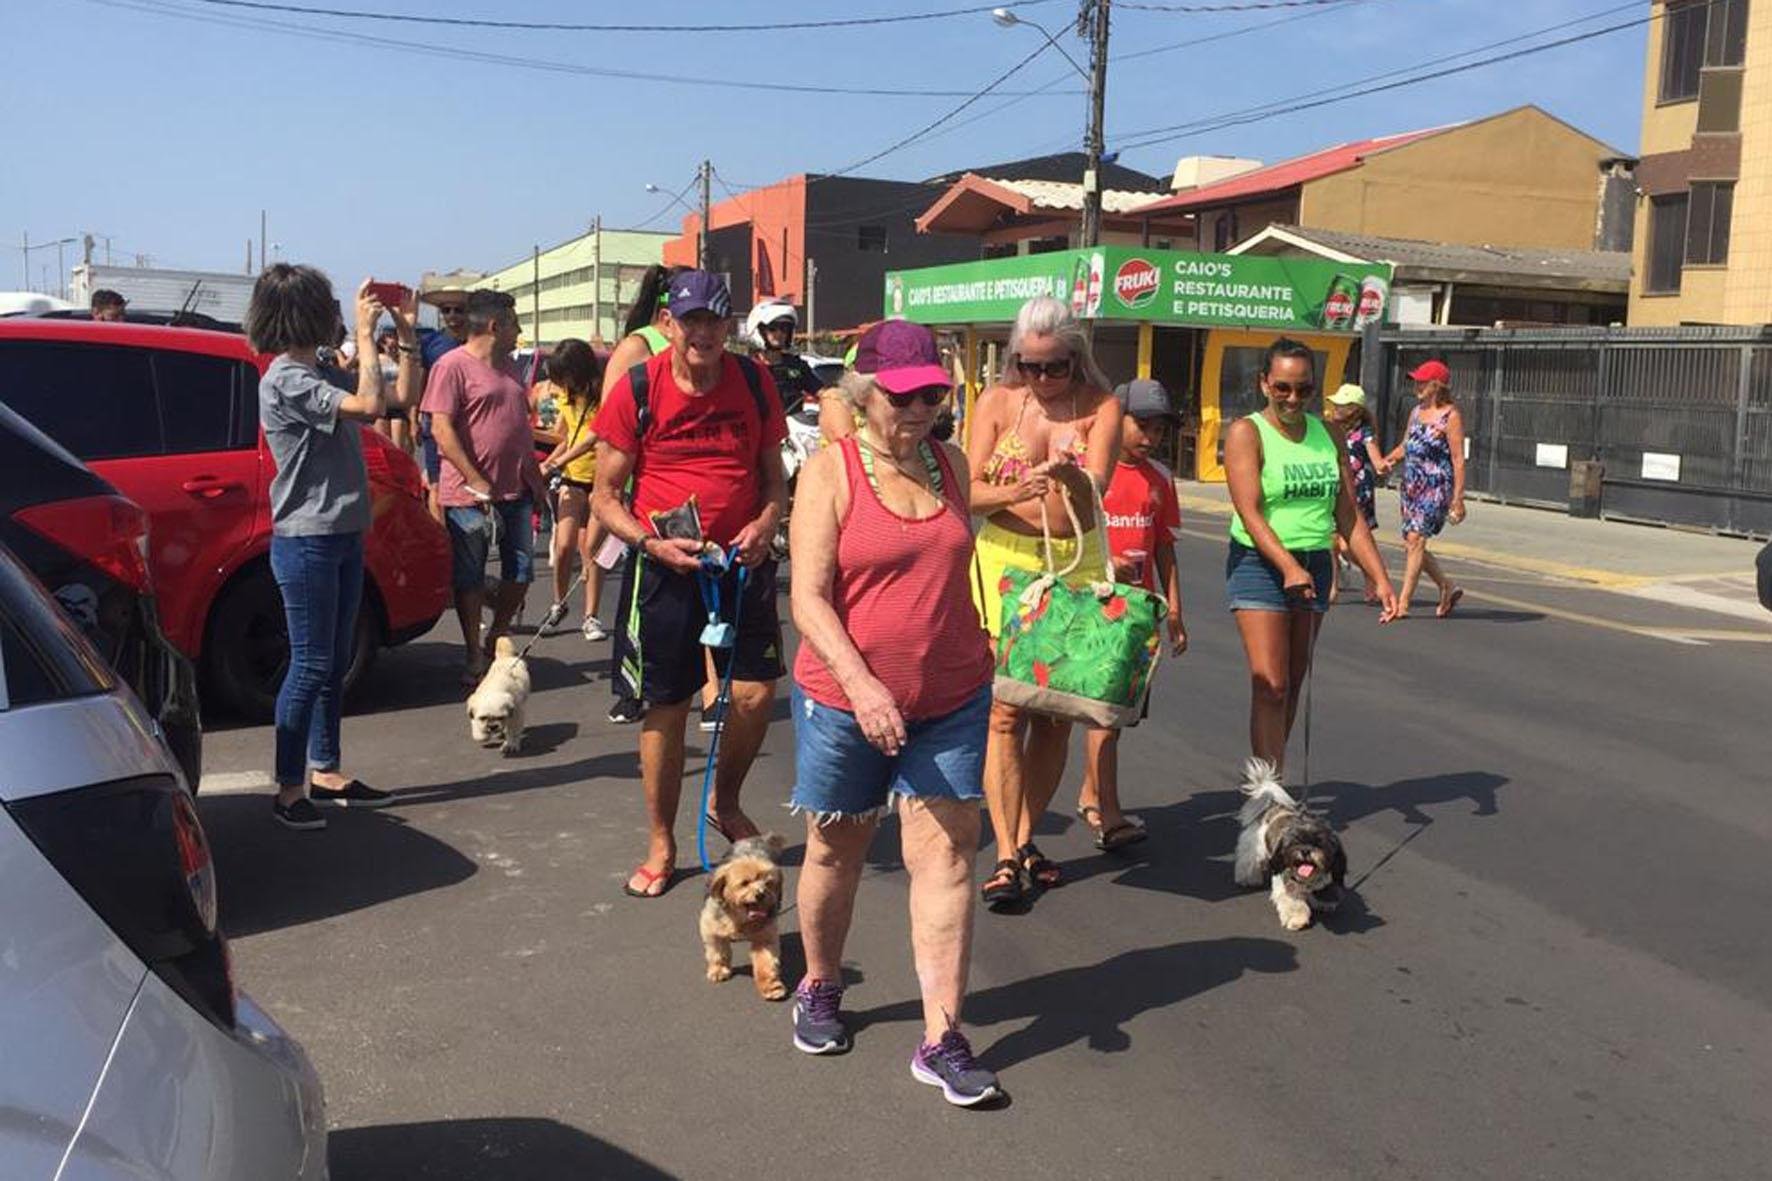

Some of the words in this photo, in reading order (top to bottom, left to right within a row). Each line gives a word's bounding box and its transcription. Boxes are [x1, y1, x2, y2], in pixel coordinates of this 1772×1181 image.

[1114, 267, 1161, 292] FRUKI
[1175, 260, 1232, 277] CAIO'S
[933, 278, 986, 304] RESTAURANTE
[987, 281, 994, 300] E
[1173, 279, 1293, 301] RESTAURANTE
[1172, 299, 1184, 315] E
[1187, 302, 1296, 321] PETISQUERIA
[1283, 462, 1336, 481] MUDE
